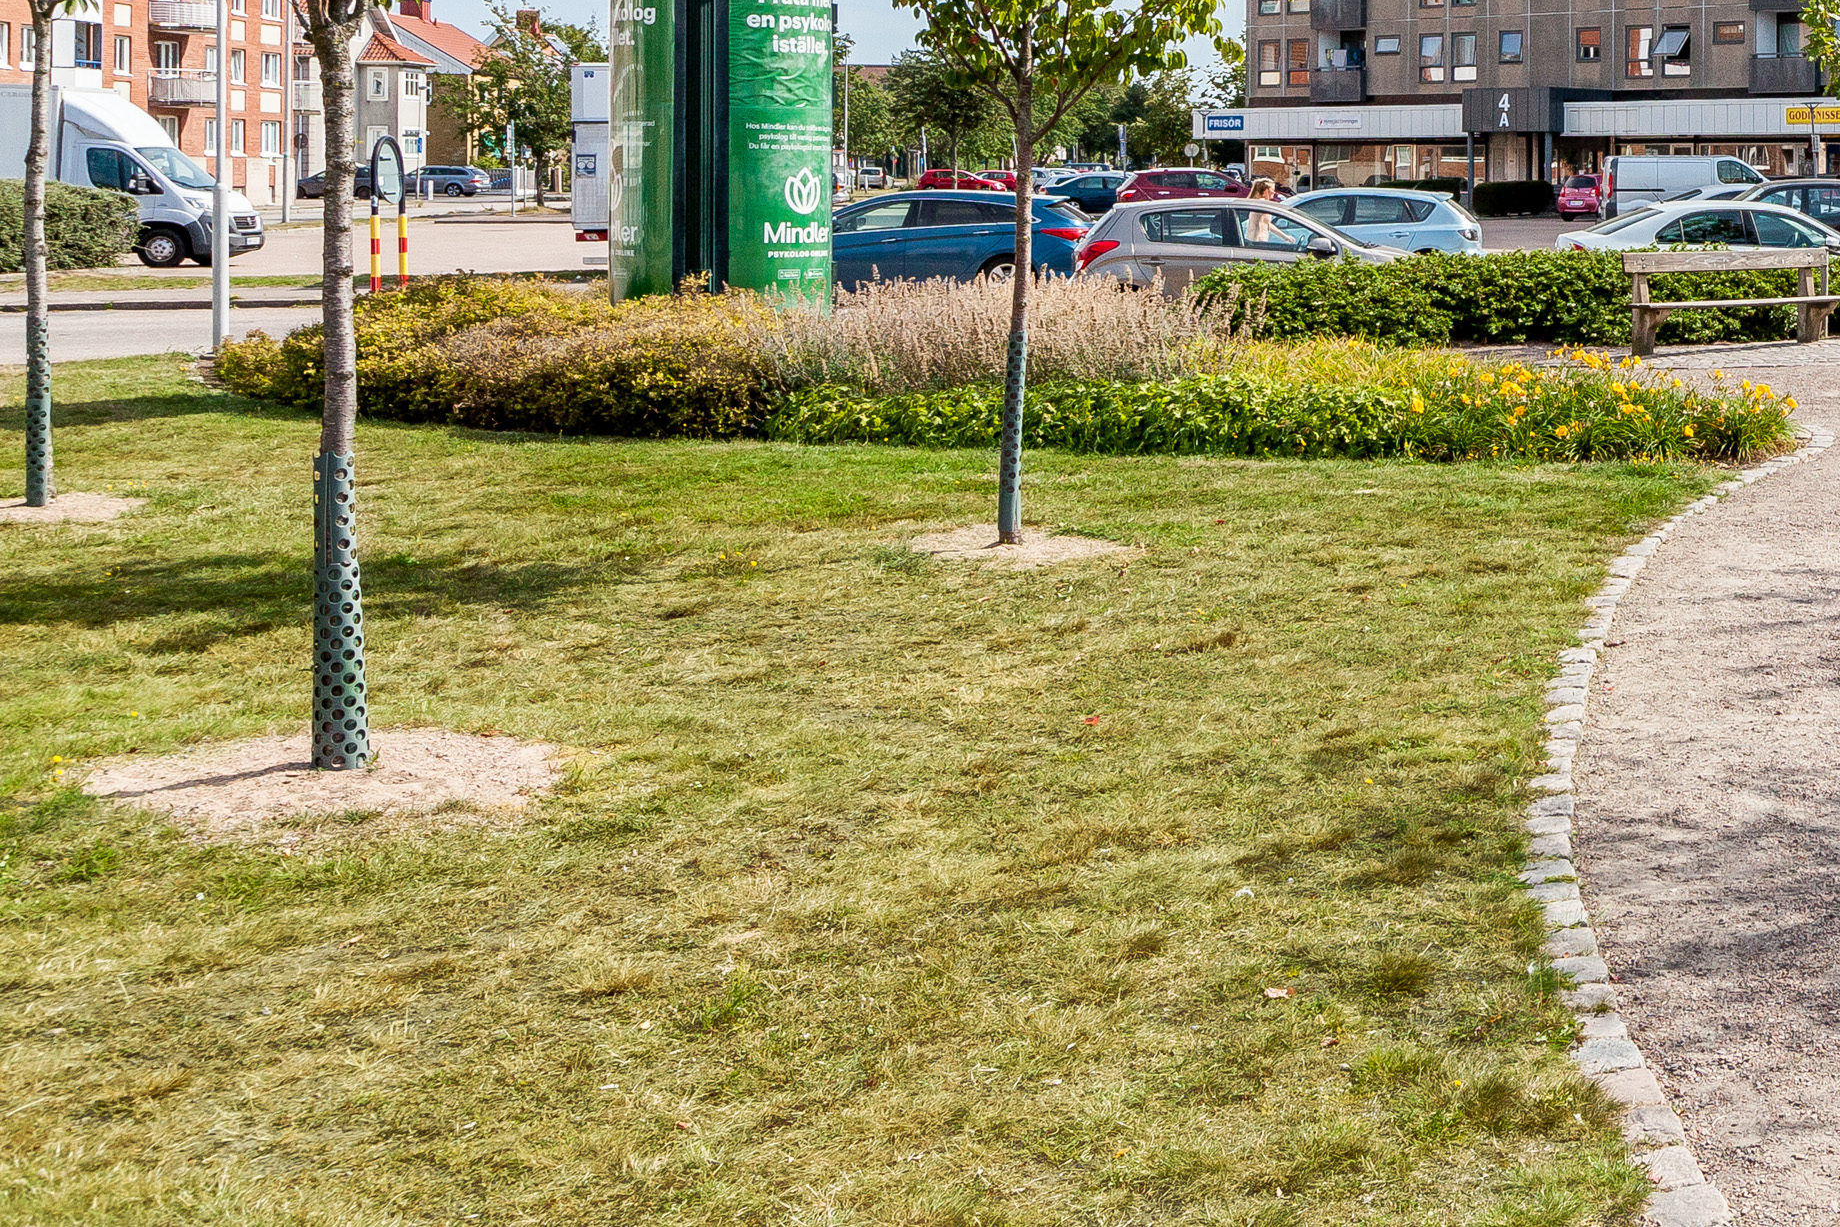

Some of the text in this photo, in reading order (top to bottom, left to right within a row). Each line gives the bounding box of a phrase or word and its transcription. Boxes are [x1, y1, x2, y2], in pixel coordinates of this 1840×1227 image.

[746, 12, 832, 34] en psykolo
[1498, 93, 1511, 112] 4
[1208, 116, 1242, 128] FRISÖR
[1499, 112, 1510, 127] A
[745, 122, 760, 130] Hos
[761, 122, 786, 130] Mindler
[758, 133, 789, 142] psykolog
[748, 142, 760, 150] Du
[761, 141, 770, 150] får
[763, 221, 830, 244] Mindler
[767, 250, 810, 259] PSYKOLOG
